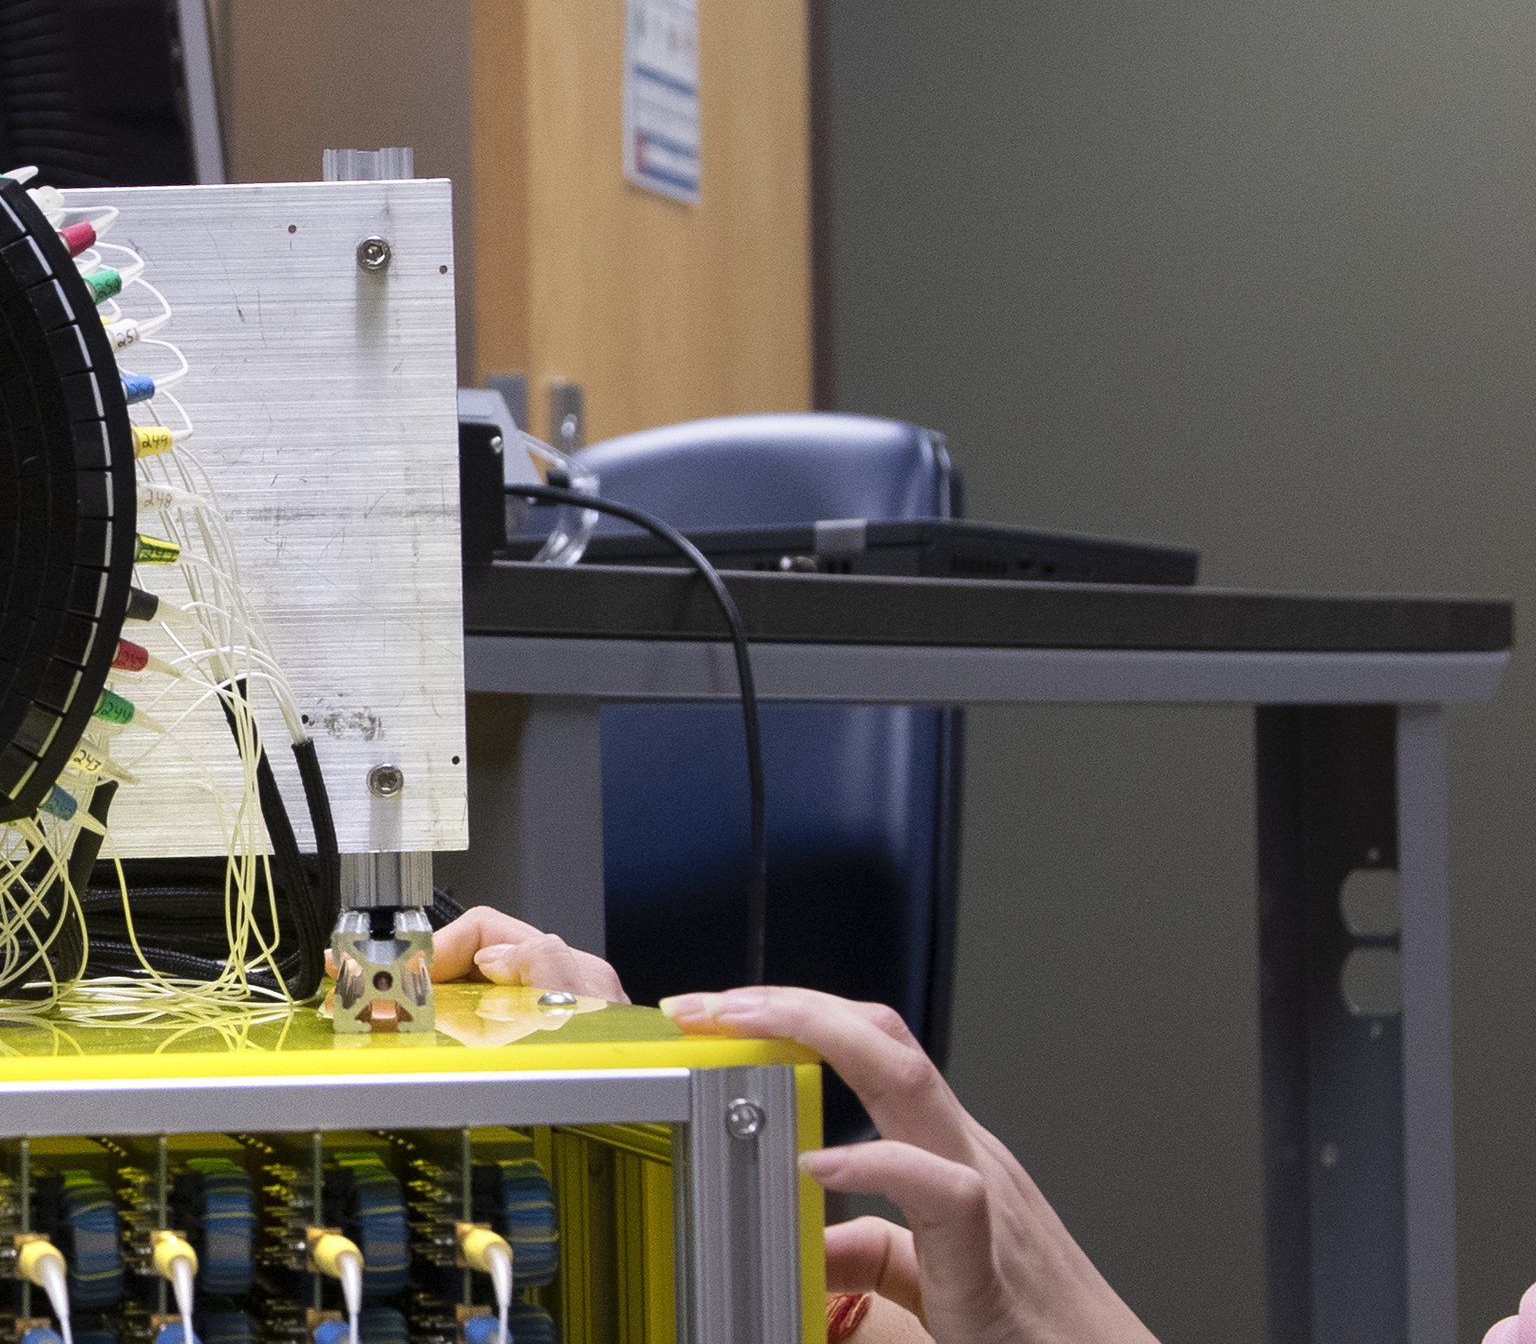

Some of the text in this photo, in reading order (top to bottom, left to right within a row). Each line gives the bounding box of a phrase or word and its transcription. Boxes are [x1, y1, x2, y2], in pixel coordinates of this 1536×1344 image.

[116, 327, 138, 348] 251
[141, 433, 169, 449] 249
[143, 488, 173, 508] 248
[100, 701, 132, 719] 244
[73, 748, 101, 772] 243
